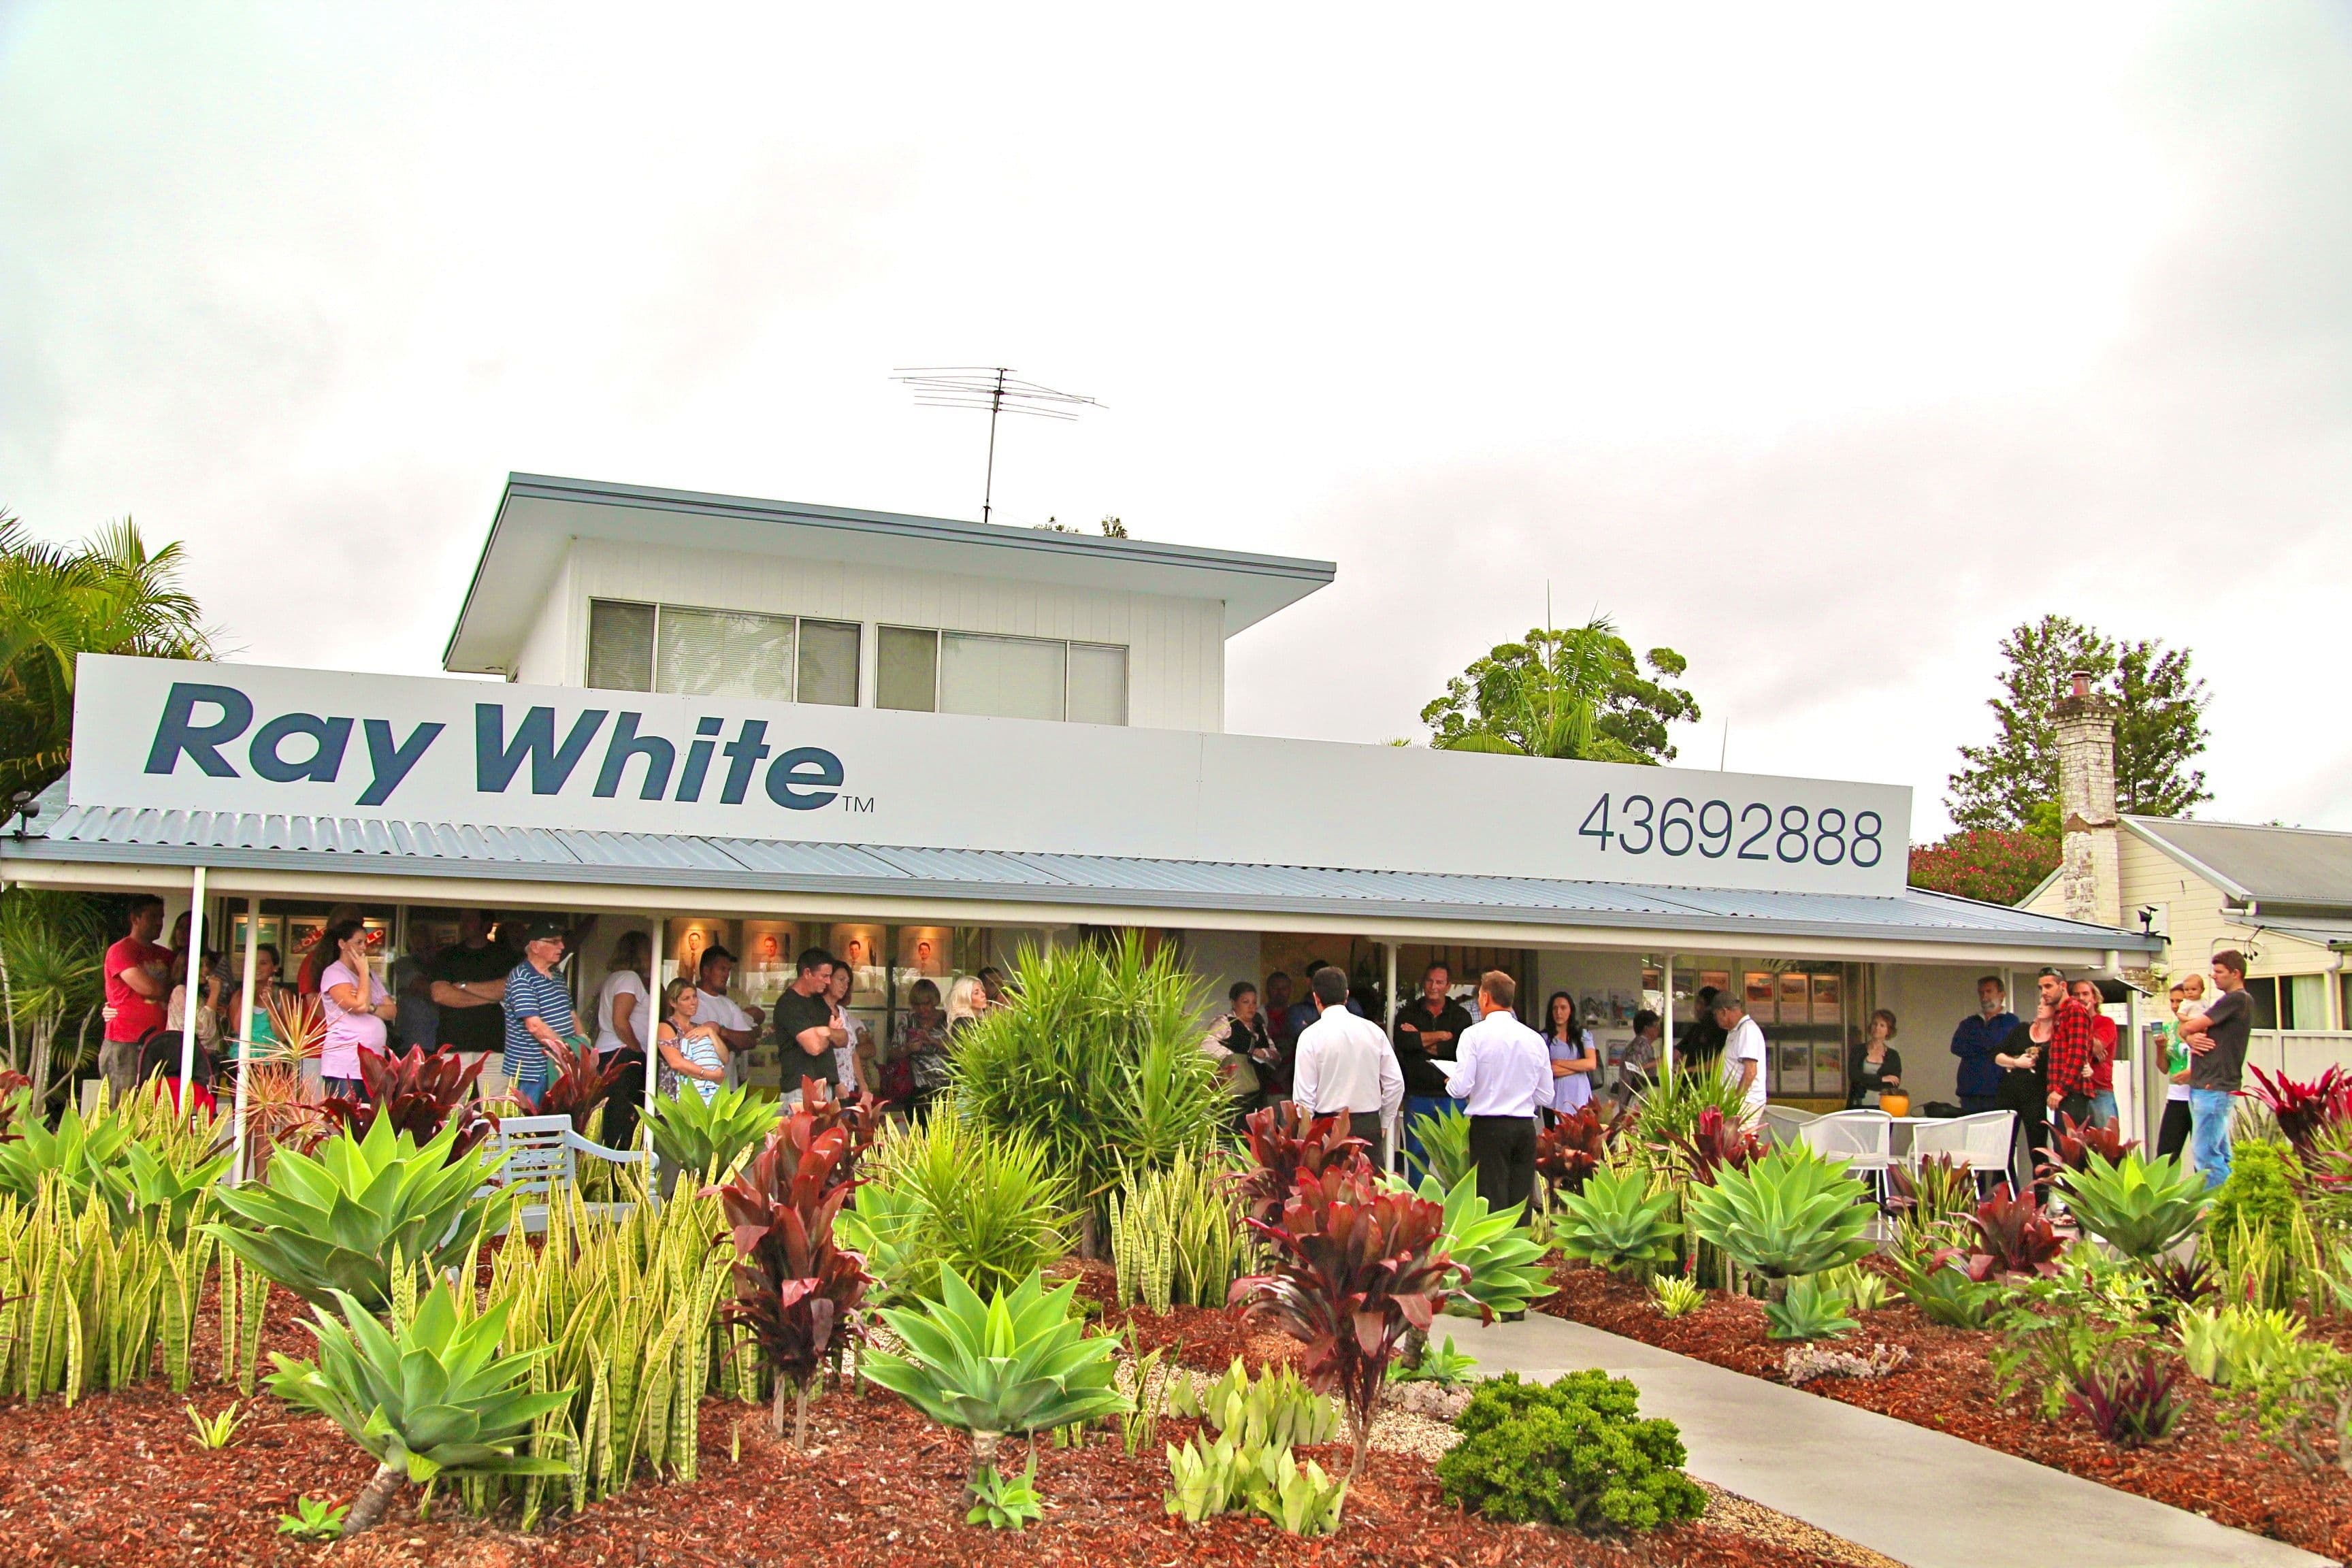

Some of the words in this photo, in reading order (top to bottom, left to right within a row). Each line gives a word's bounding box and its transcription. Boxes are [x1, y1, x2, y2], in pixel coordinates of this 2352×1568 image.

[143, 682, 447, 806] Ray
[475, 702, 845, 811] White
[842, 796, 875, 814] TM
[1578, 792, 1882, 868] 43692888
